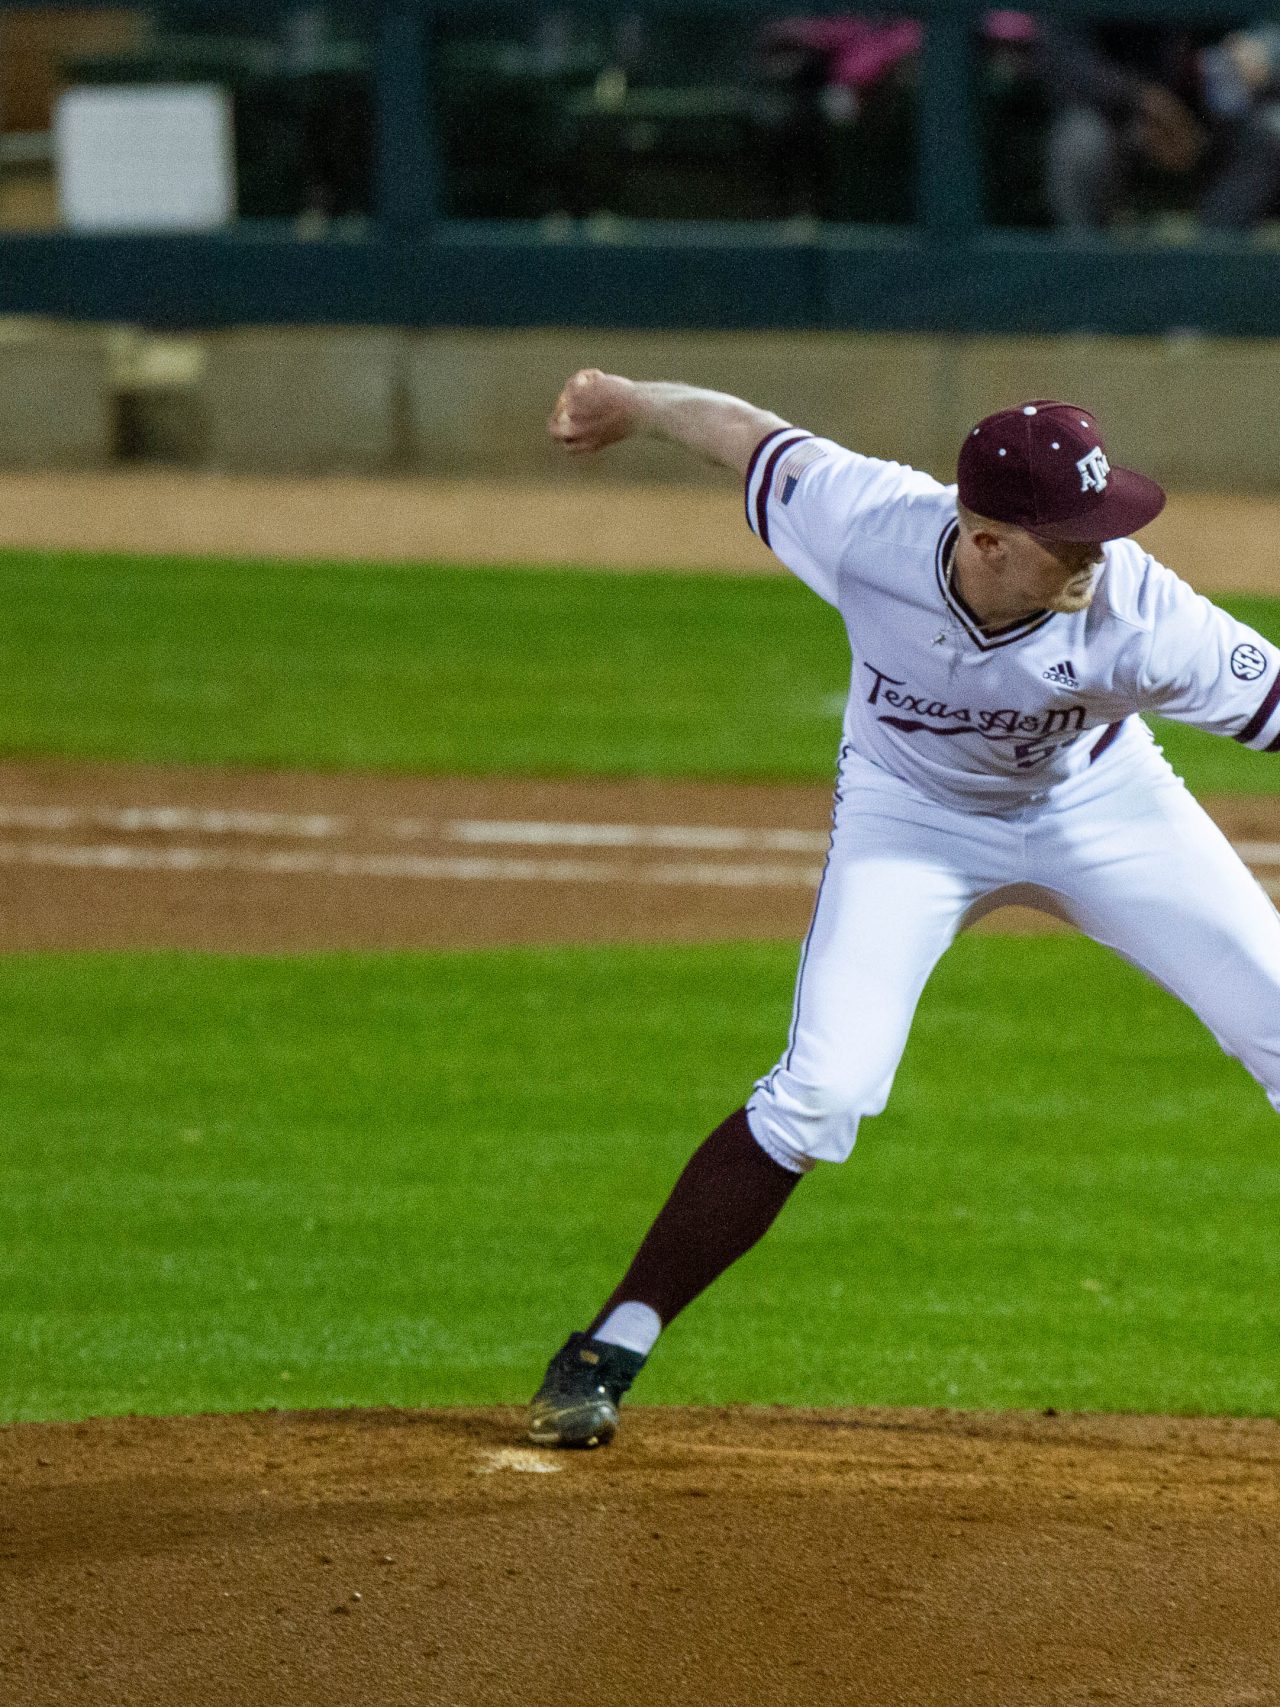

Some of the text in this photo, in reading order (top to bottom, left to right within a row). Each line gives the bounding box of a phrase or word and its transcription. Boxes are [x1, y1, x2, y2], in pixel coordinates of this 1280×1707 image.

[1043, 671, 1079, 689] adidas
[1231, 644, 1267, 681] SEC
[864, 662, 970, 722] Texas
